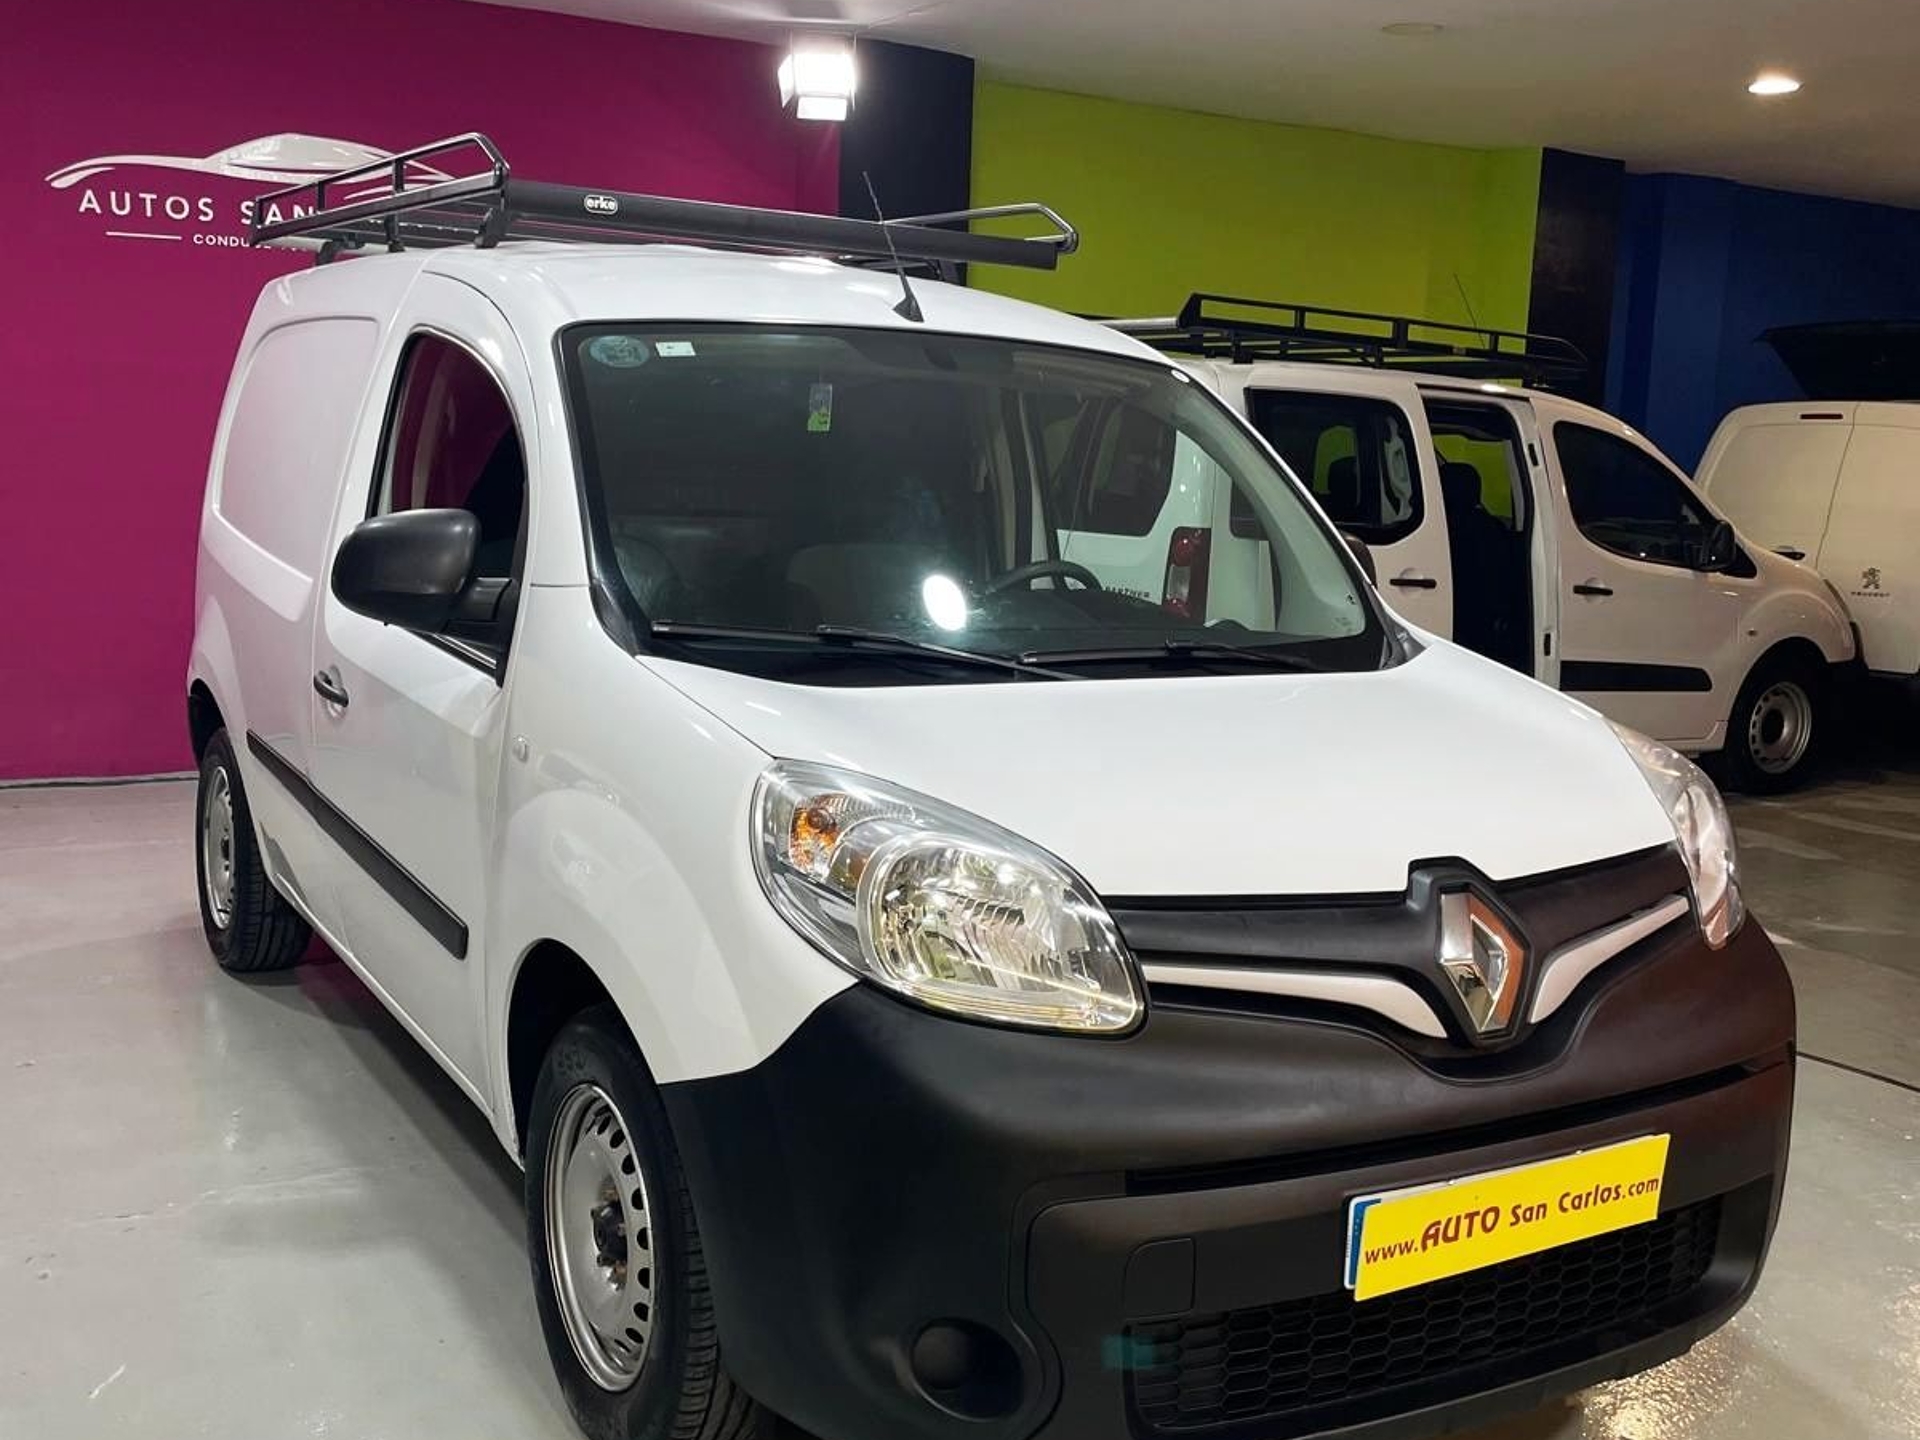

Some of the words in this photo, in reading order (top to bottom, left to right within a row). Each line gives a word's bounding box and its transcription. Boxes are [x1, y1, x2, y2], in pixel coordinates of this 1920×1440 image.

[79, 189, 214, 221] AUTOS
[193, 233, 272, 249] CONDU
[1364, 1205, 1500, 1265] www.AUTO
[1509, 1202, 1547, 1227] San
[1558, 1177, 1660, 1214] Carlos.com
